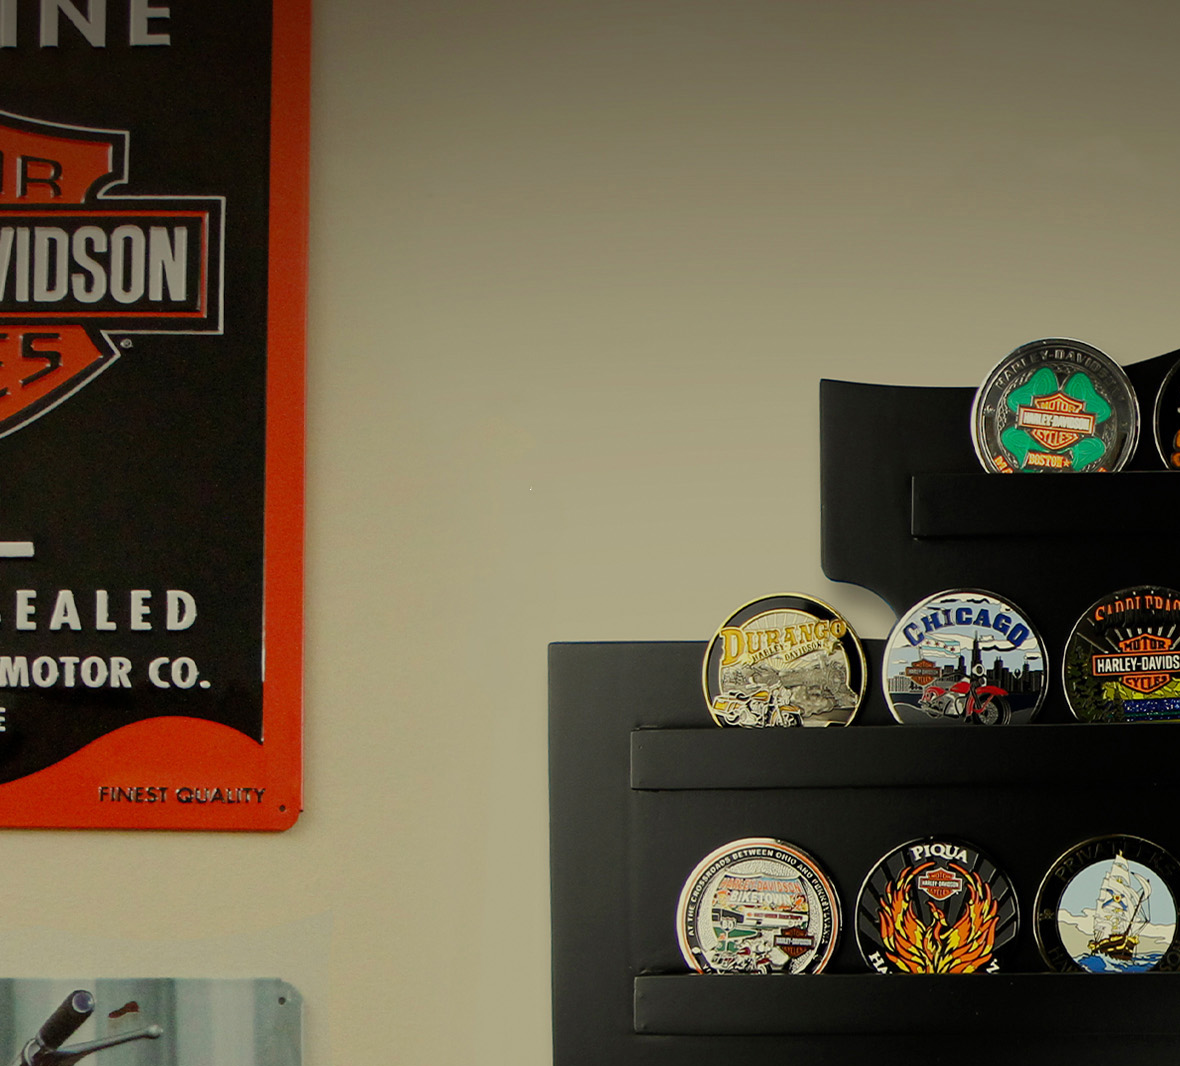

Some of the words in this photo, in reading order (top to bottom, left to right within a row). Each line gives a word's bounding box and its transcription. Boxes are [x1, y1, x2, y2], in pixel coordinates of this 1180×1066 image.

[1027, 453, 1063, 468] BOSTON
[903, 607, 1030, 647] CHICAGO
[721, 620, 847, 666] DURANGO
[1, 656, 132, 689] MOTOR
[148, 656, 212, 689] CO.
[98, 787, 168, 803] FINEST
[176, 787, 265, 804] QUALITY
[910, 843, 968, 864] PIQUA
[691, 856, 732, 905] CROSSROADS
[732, 848, 775, 861] BETWEEN
[775, 851, 797, 867] OHIO
[734, 891, 793, 906] BIKETOWN
